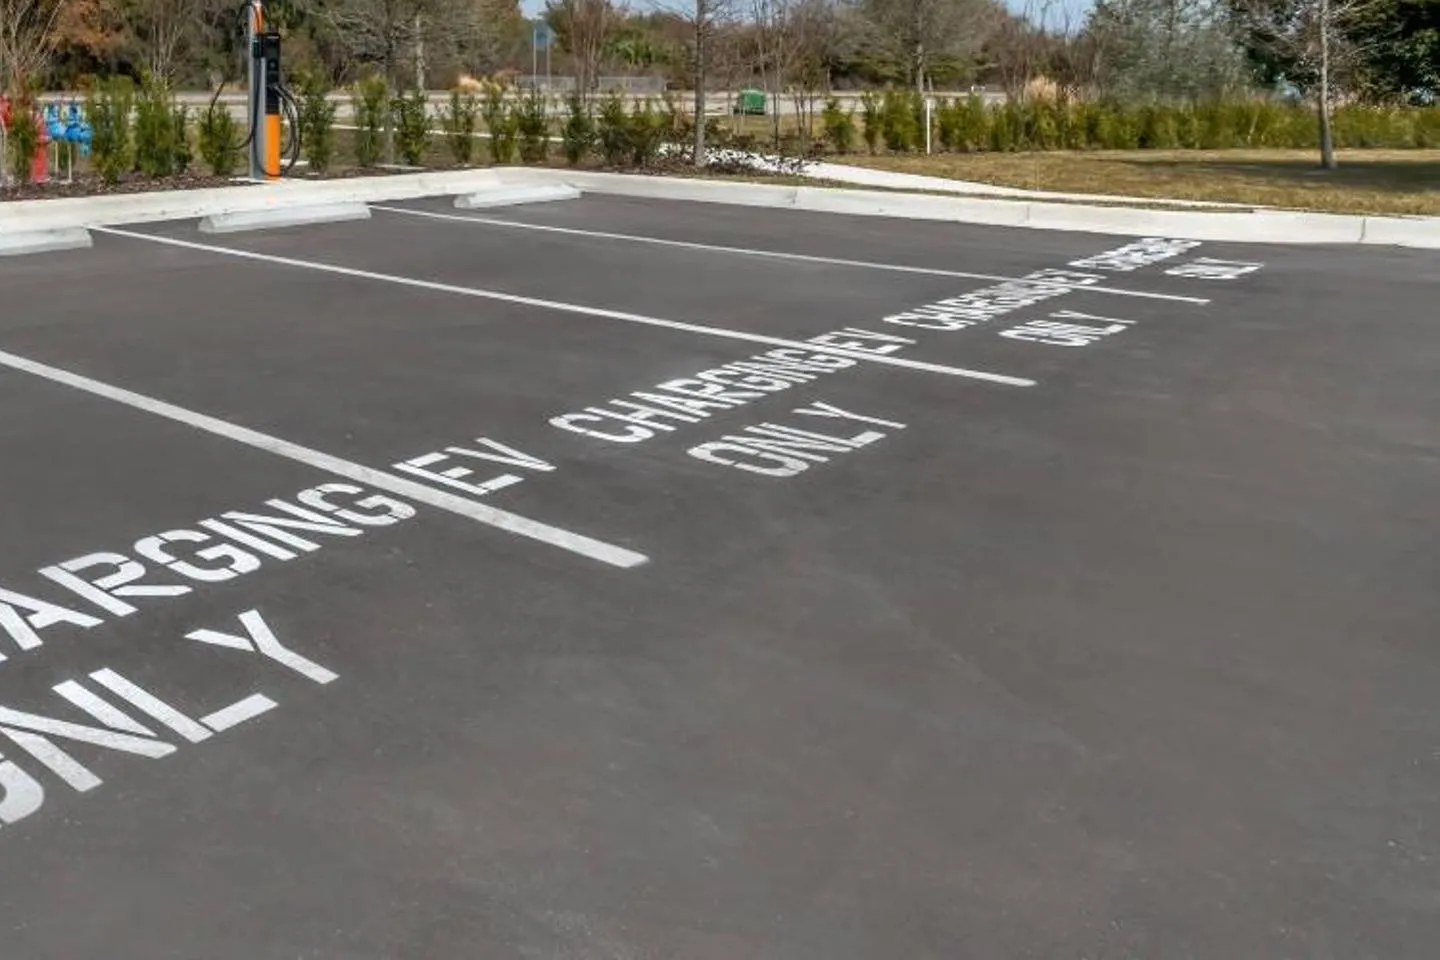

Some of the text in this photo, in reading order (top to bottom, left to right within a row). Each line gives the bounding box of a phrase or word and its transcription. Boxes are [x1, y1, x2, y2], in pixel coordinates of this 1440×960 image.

[806, 327, 917, 354] EV
[391, 348, 859, 496] EV CHARGING
[686, 401, 907, 477] ONLY
